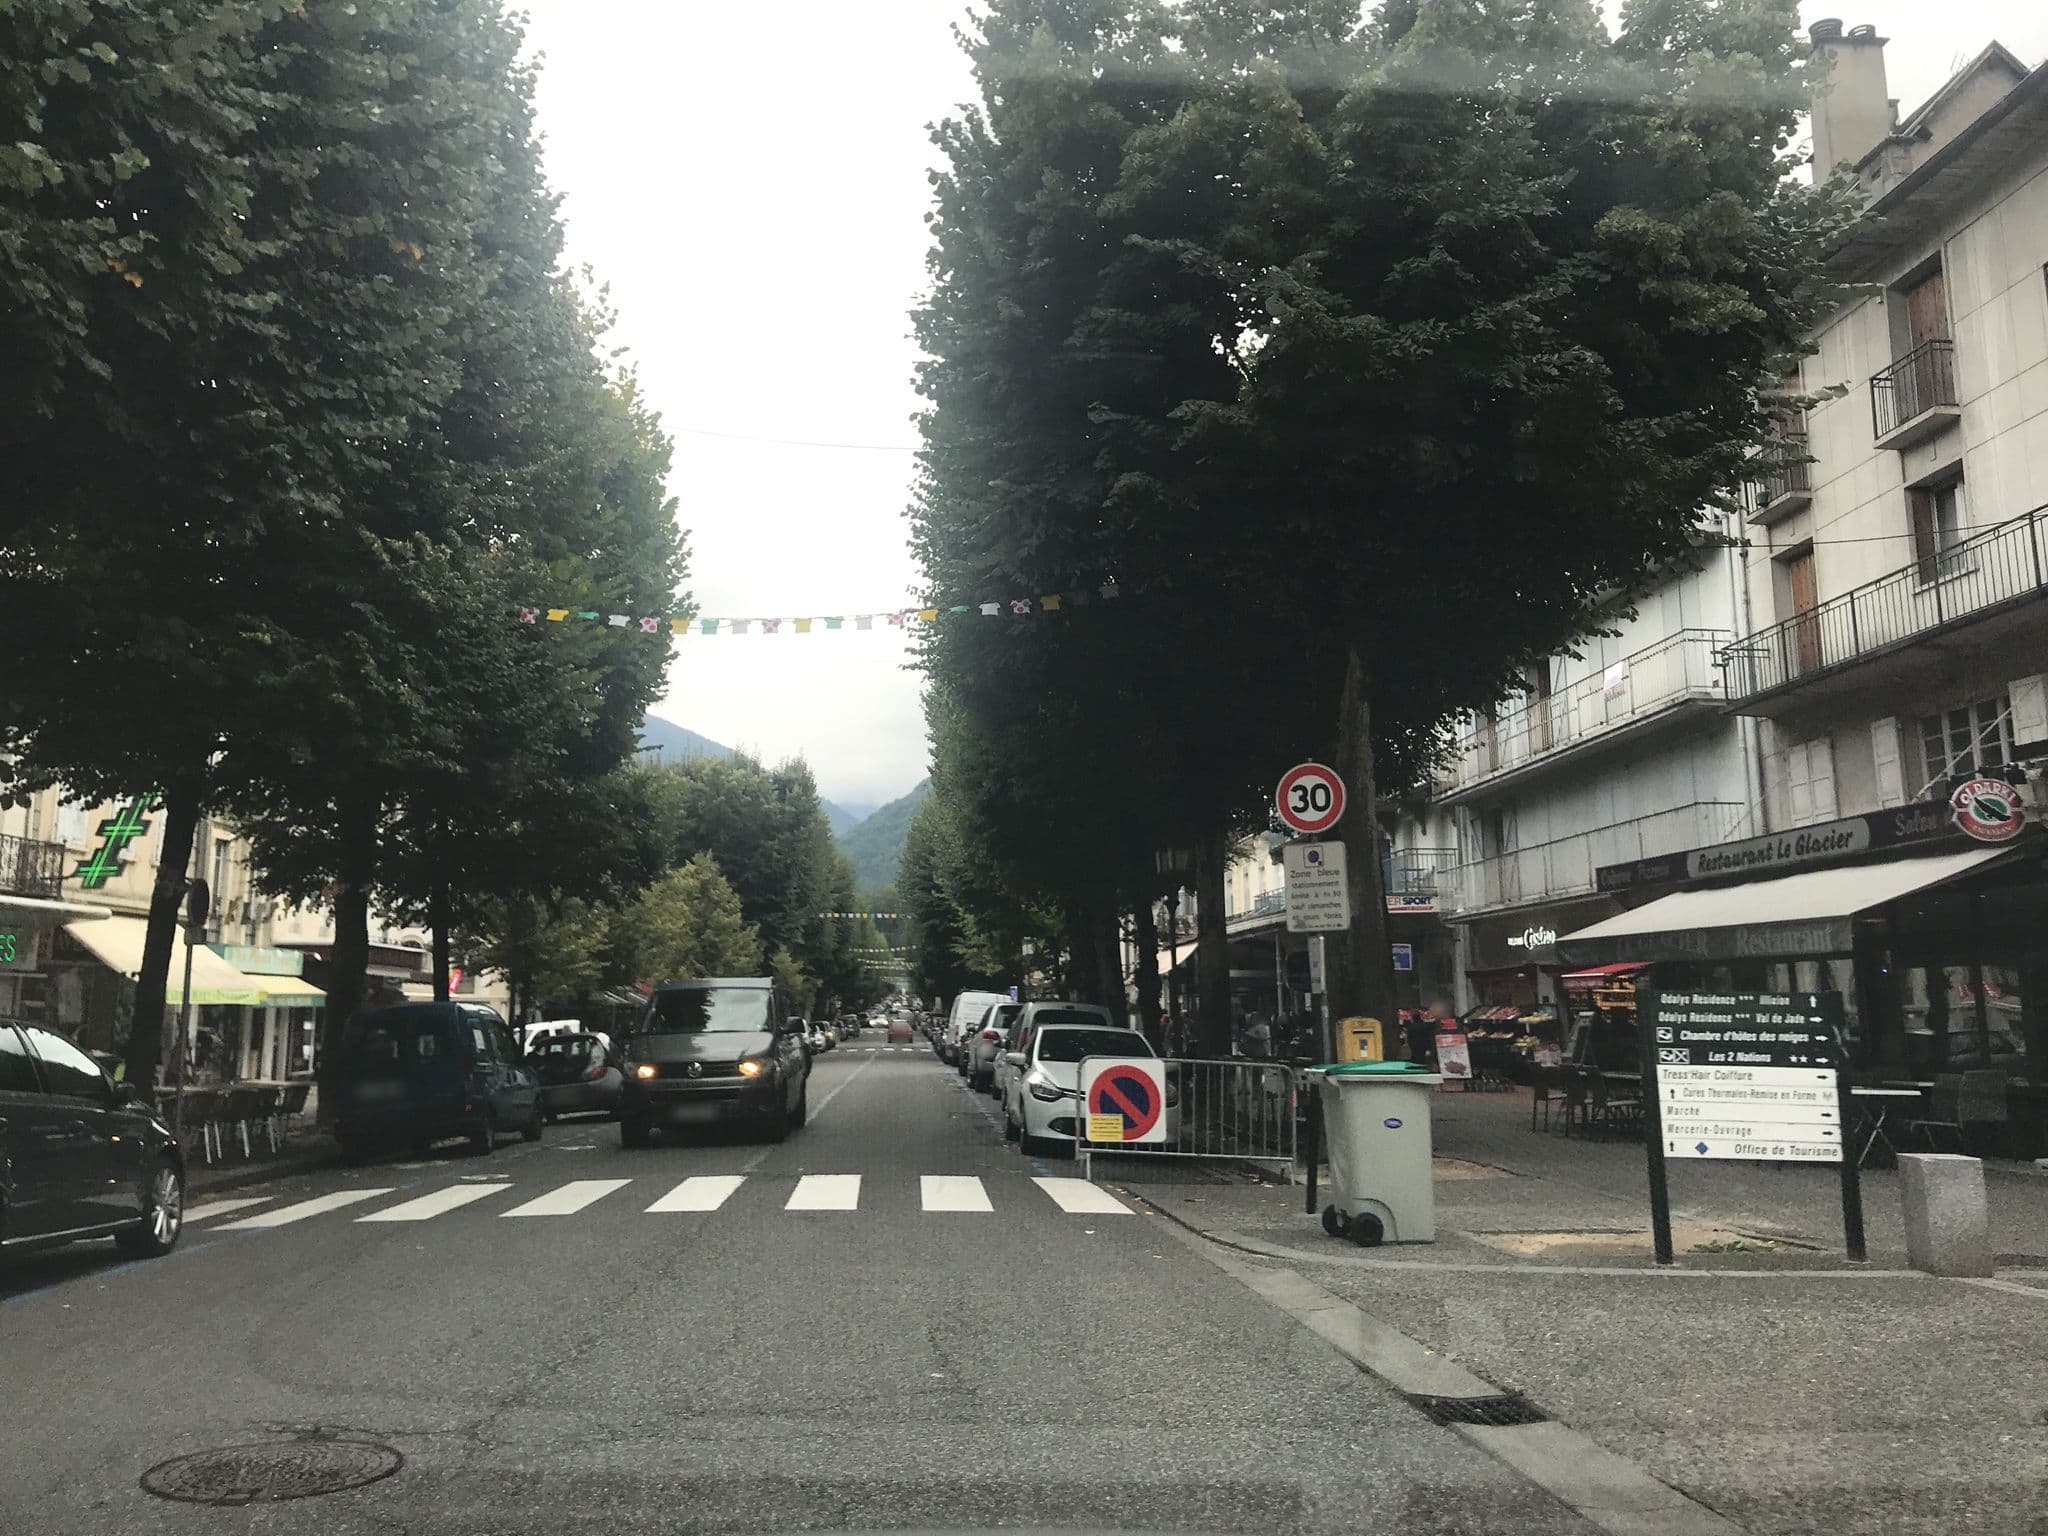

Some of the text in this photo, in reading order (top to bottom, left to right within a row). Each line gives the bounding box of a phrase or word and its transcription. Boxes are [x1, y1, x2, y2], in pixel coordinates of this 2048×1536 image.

[1291, 783, 1331, 813] 30
[1698, 842, 1773, 873] Restaurant
[1777, 838, 1792, 859] Le
[1795, 828, 1854, 856] Glacier
[1290, 870, 1311, 878] Zone
[1403, 896, 1431, 905] SPORT
[1755, 1013, 1770, 1023] Val
[1771, 1012, 1783, 1023] de
[1784, 1012, 1805, 1024] Jade
[1680, 1030, 1721, 1041] Chambre
[1758, 1030, 1776, 1042] des
[1777, 1031, 1809, 1044] neiges
[1708, 1051, 1771, 1063] Les 2 Nations
[1714, 1069, 1753, 1081] Coiffure
[1683, 1087, 1705, 1098] Cures
[1780, 1091, 1791, 1100] en
[1793, 1090, 1817, 1101] Forme
[1734, 1143, 1838, 1157] Office de Tourisme
